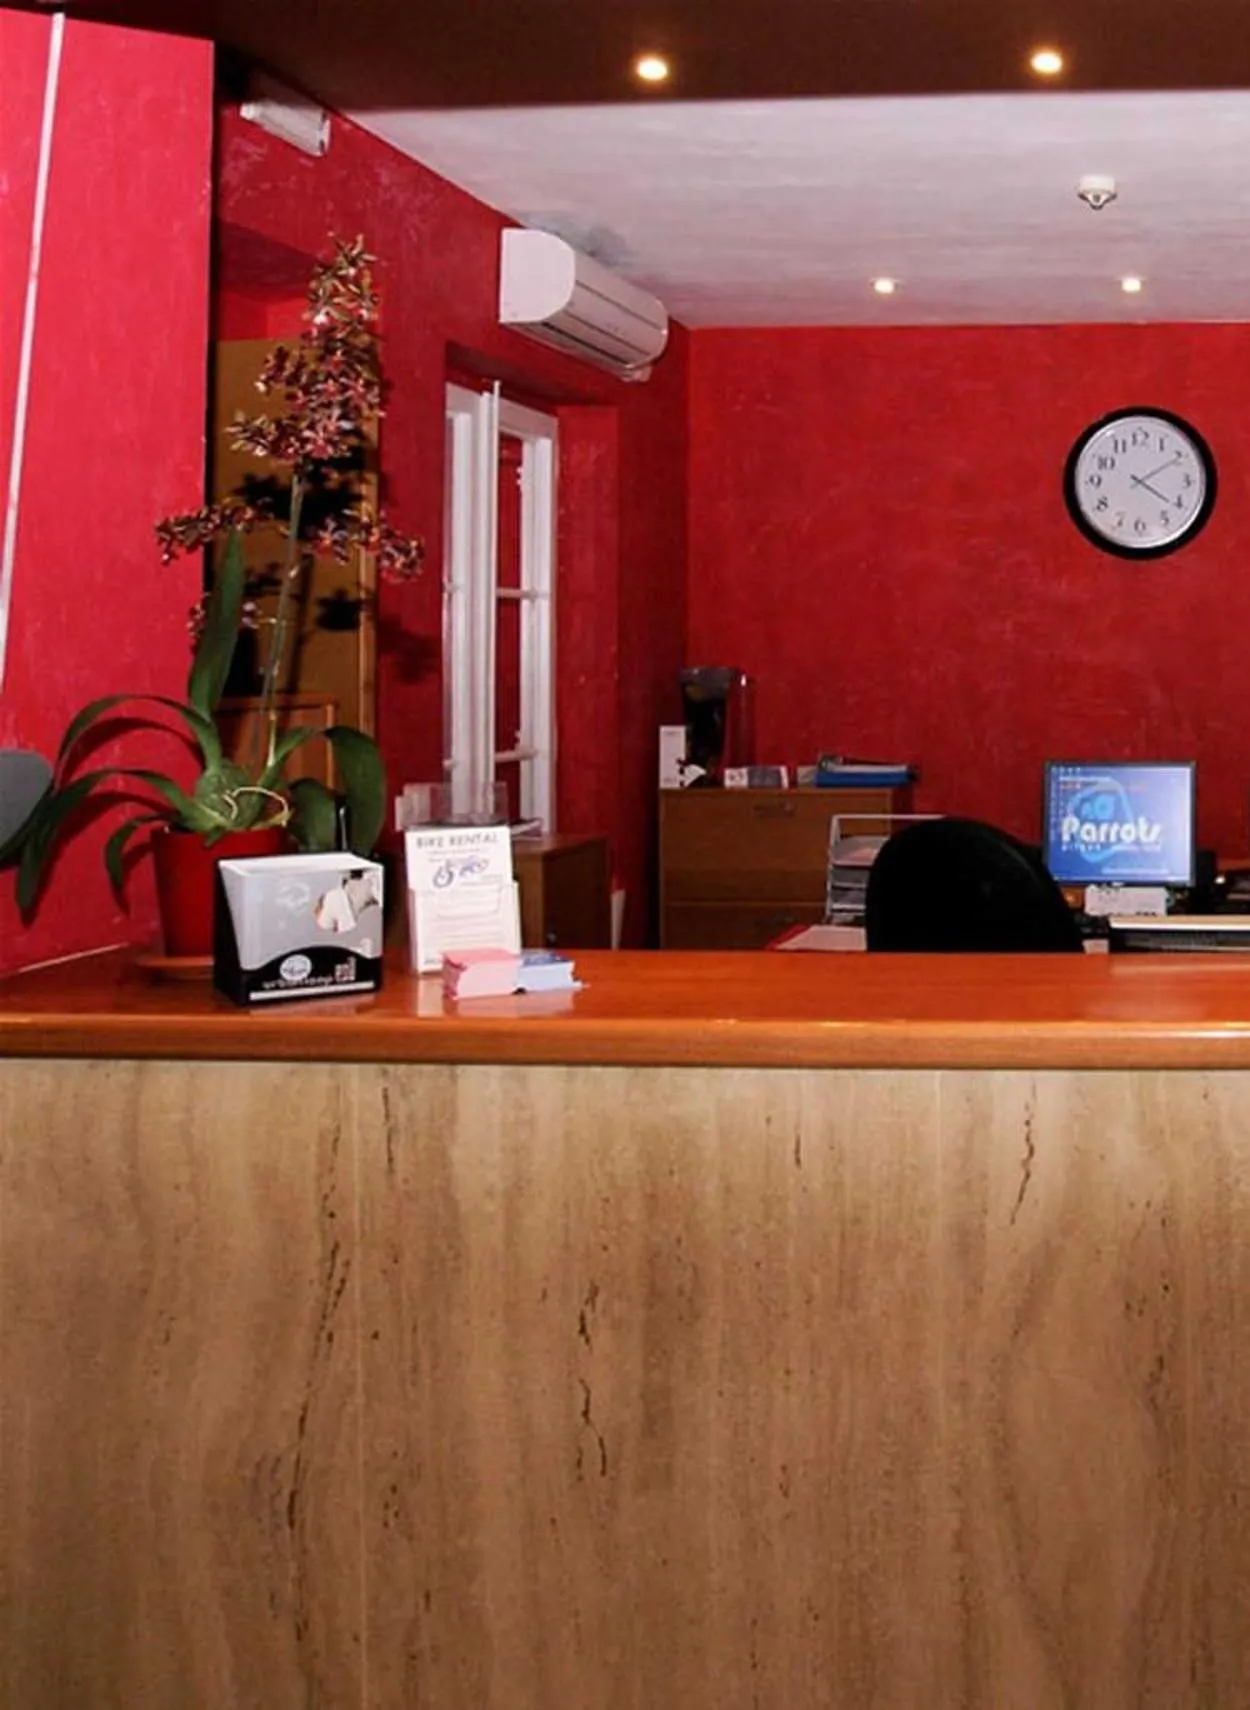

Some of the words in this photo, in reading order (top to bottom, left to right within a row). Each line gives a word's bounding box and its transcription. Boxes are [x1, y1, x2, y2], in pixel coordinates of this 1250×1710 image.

[1132, 426, 1149, 447] 12
[1114, 439, 1127, 453] 11
[1097, 456, 1116, 471] 10
[1088, 473, 1102, 488] 9
[1096, 496, 1108, 512] 8
[1172, 495, 1184, 509] 4
[1160, 511, 1170, 526] 5
[1134, 518, 1147, 535] 6
[1061, 815, 1162, 843] Parrots
[416, 836, 444, 848] BIKE
[449, 832, 499, 847] RENTAL
